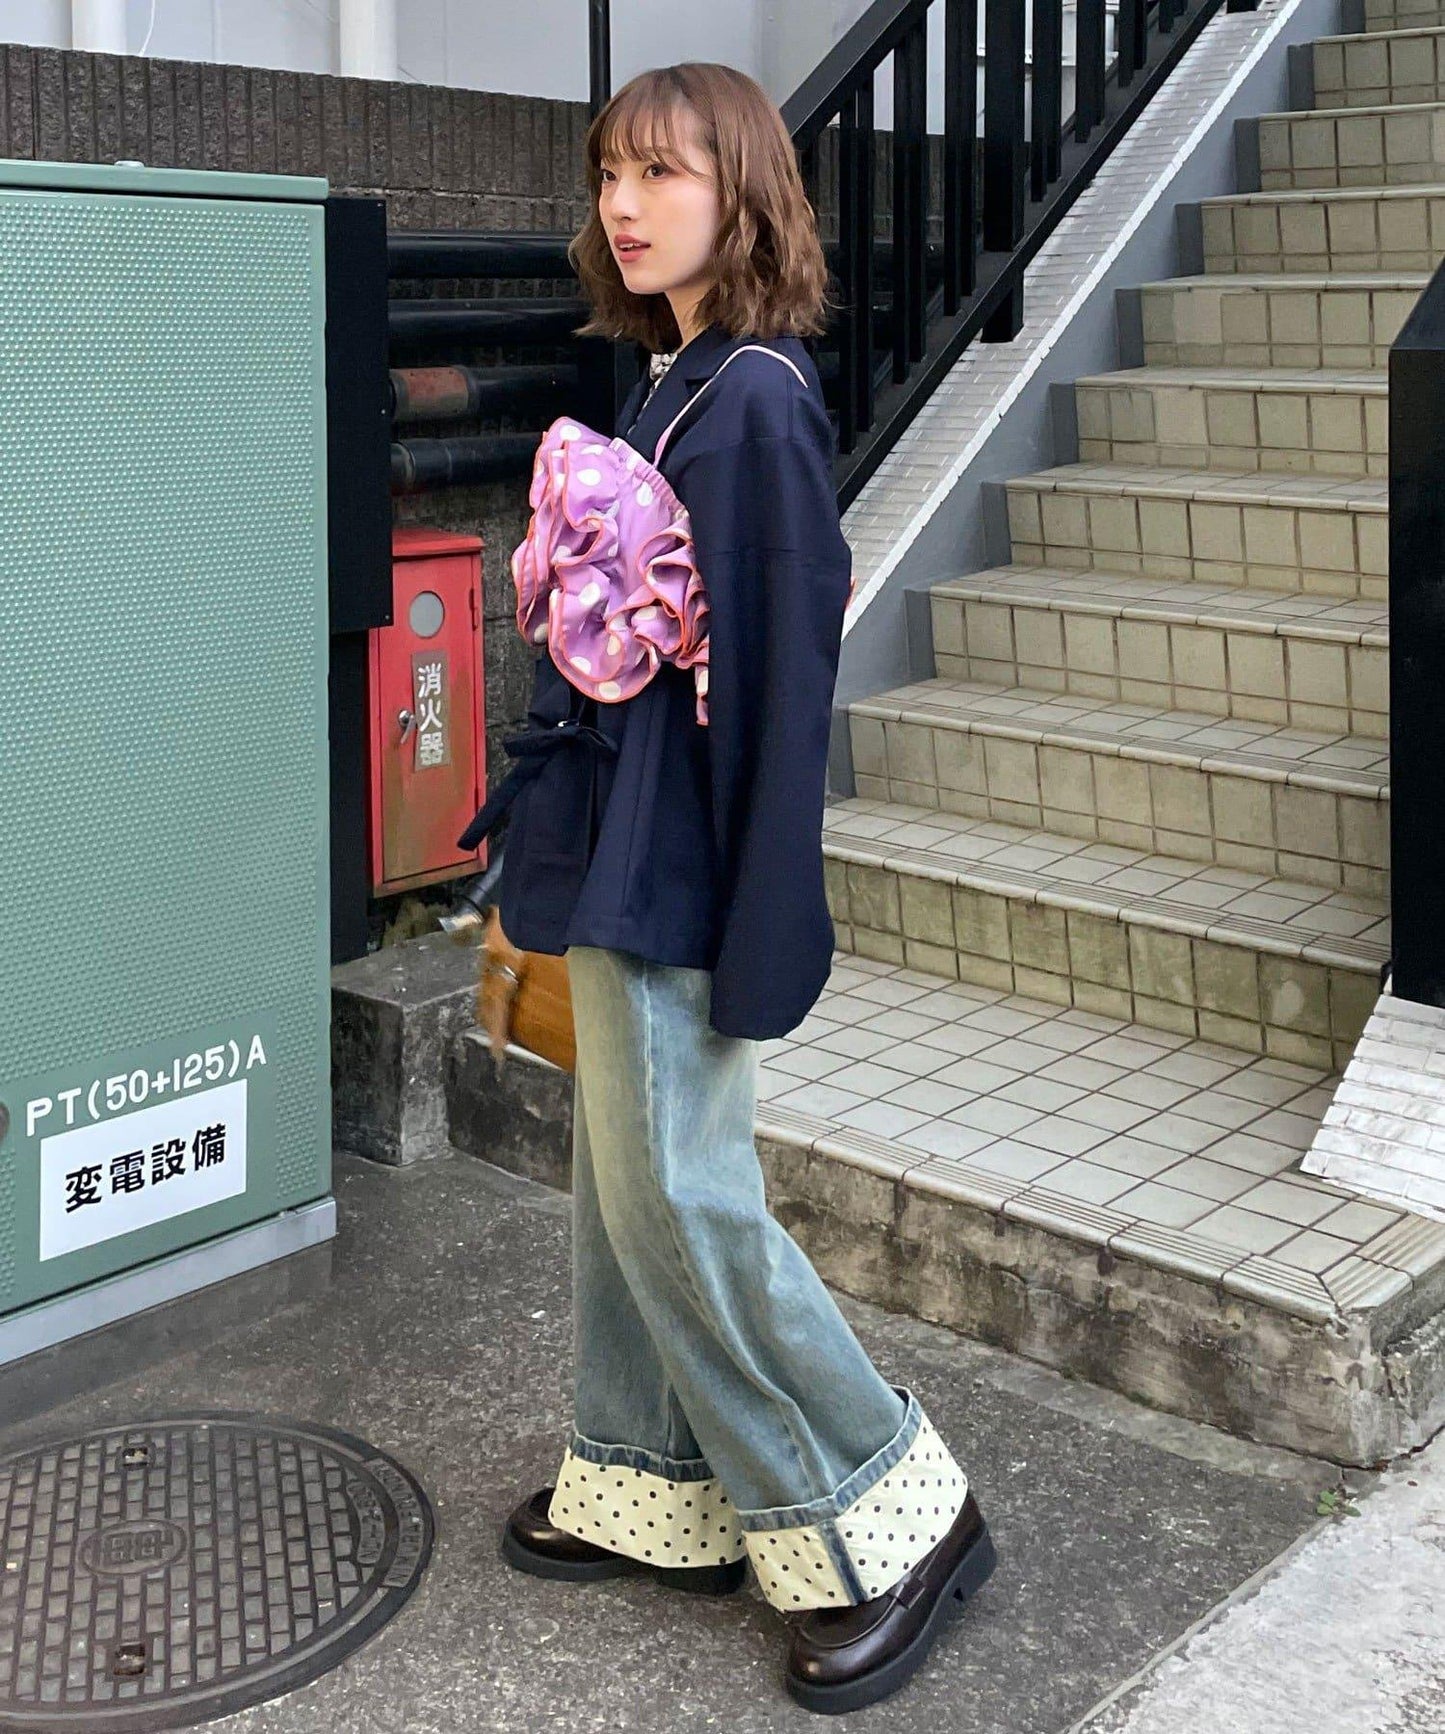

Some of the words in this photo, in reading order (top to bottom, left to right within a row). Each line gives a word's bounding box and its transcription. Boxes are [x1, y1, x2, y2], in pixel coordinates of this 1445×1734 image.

[418, 662, 444, 766] 消火器
[64, 1123, 227, 1214] 変電設備
